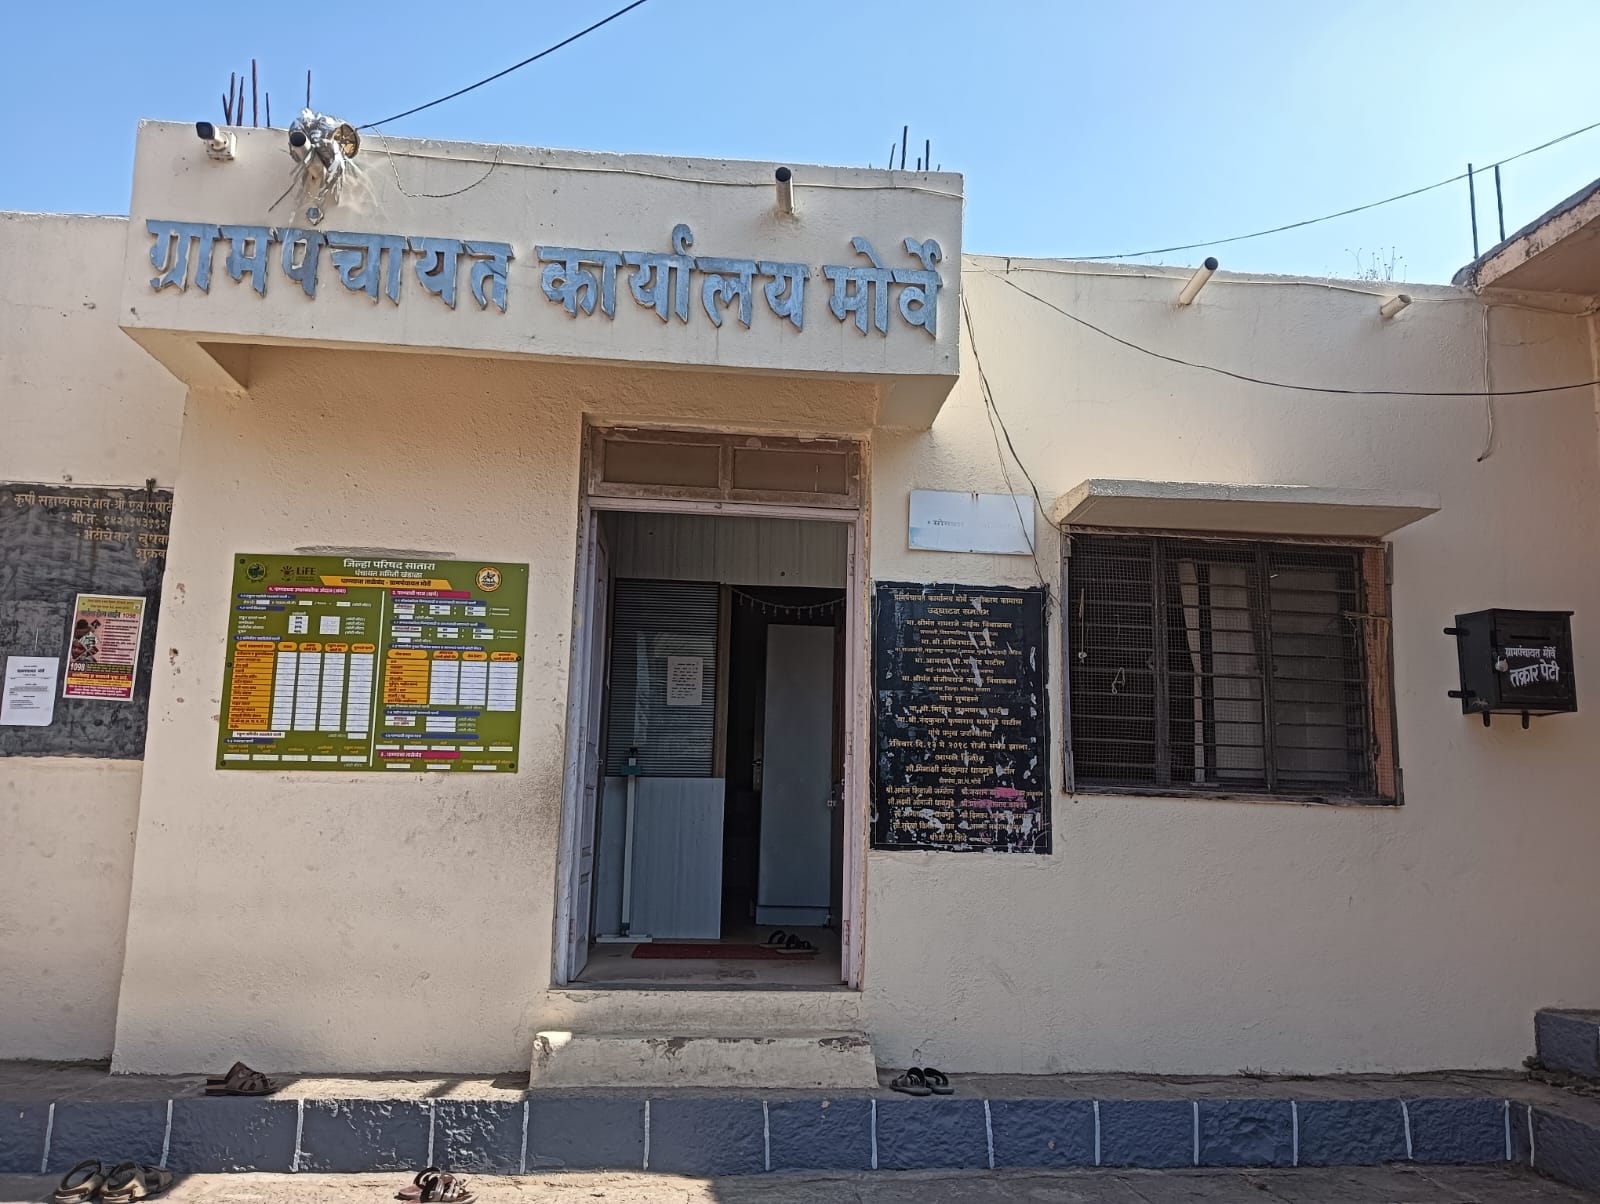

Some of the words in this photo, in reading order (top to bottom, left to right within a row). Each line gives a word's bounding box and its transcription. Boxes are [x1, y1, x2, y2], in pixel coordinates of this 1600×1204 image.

[145, 207, 514, 313] ग्रामपंचायत
[535, 224, 809, 331] कार्यालय
[822, 236, 942, 340] मोर्वे
[343, 557, 371, 568] जिल्हा
[373, 559, 403, 570] परिषद
[405, 561, 436, 571] सातारा
[296, 567, 316, 576] LiFE
[1505, 645, 1541, 659] ग्रामपंचायत
[70, 663, 86, 672] 1098
[1540, 659, 1560, 681] पेटी
